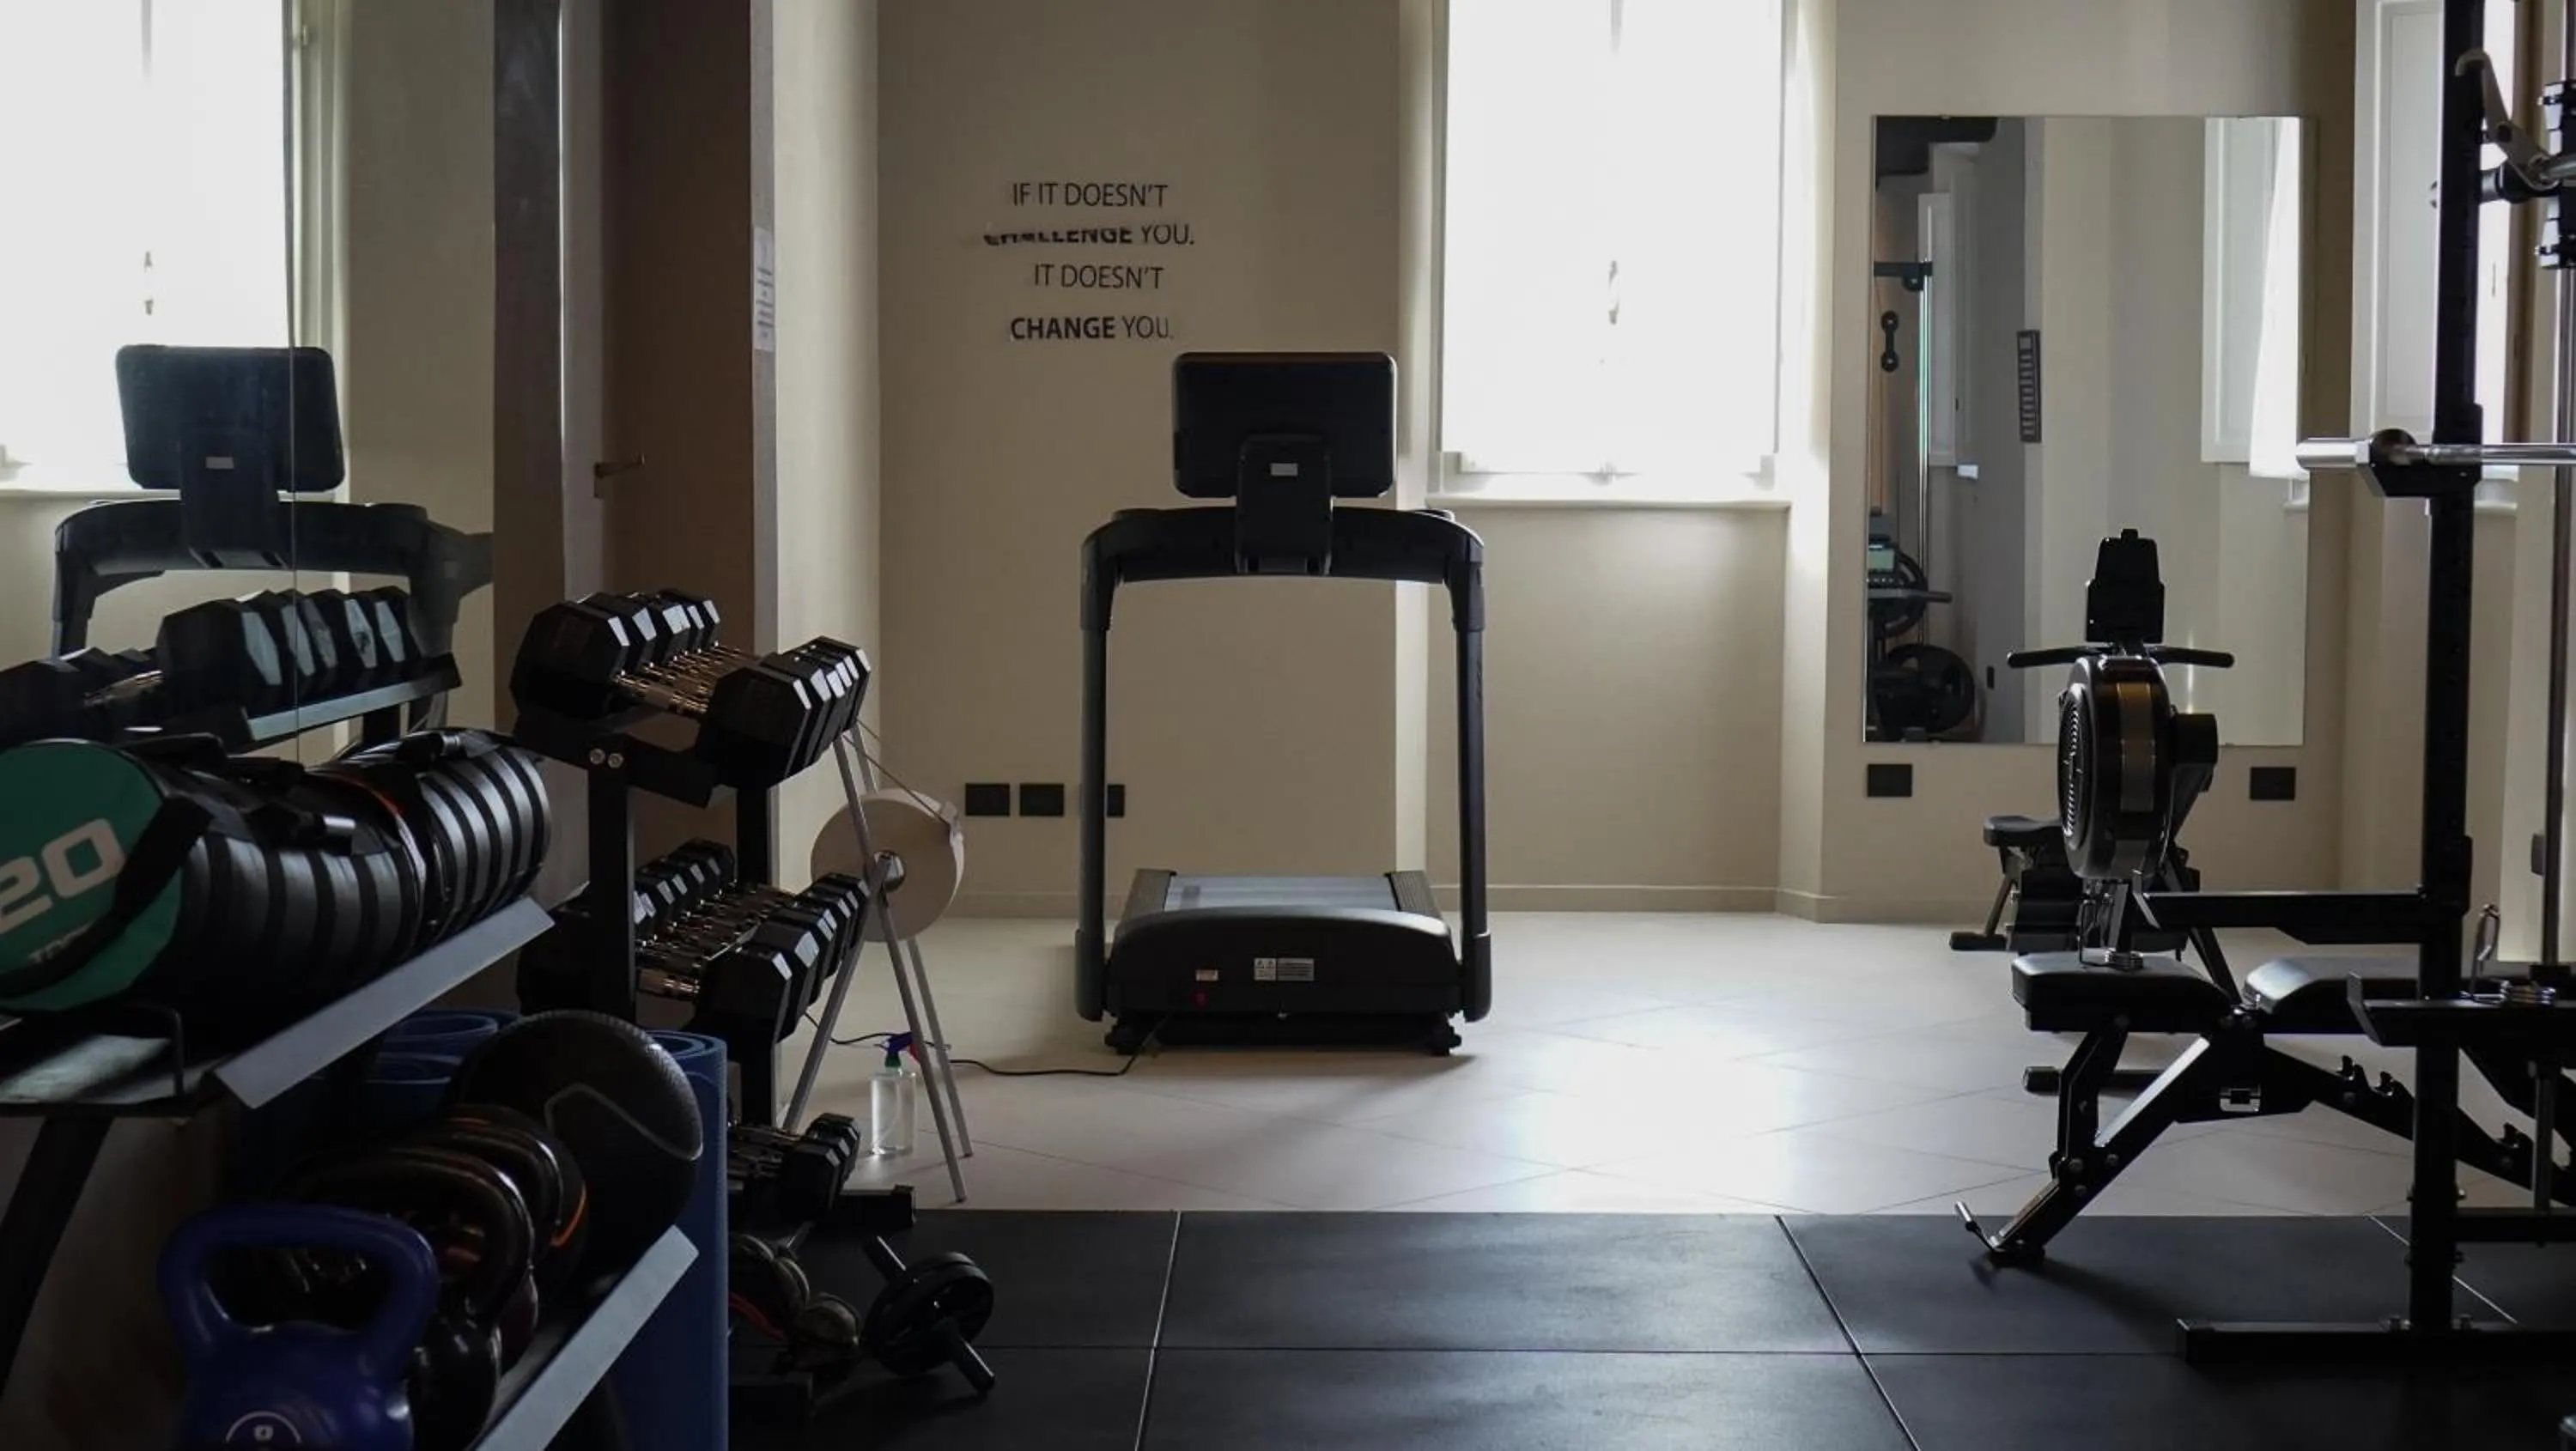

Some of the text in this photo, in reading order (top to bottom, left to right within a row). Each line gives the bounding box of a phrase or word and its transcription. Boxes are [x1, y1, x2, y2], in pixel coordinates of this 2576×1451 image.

[1012, 182, 1169, 208] IF IT DOESN'T
[1140, 223, 1195, 246] YOU.
[1035, 263, 1165, 289] IT DOESN'T
[1010, 315, 1116, 341] CHANGE
[0, 818, 125, 934] 20
